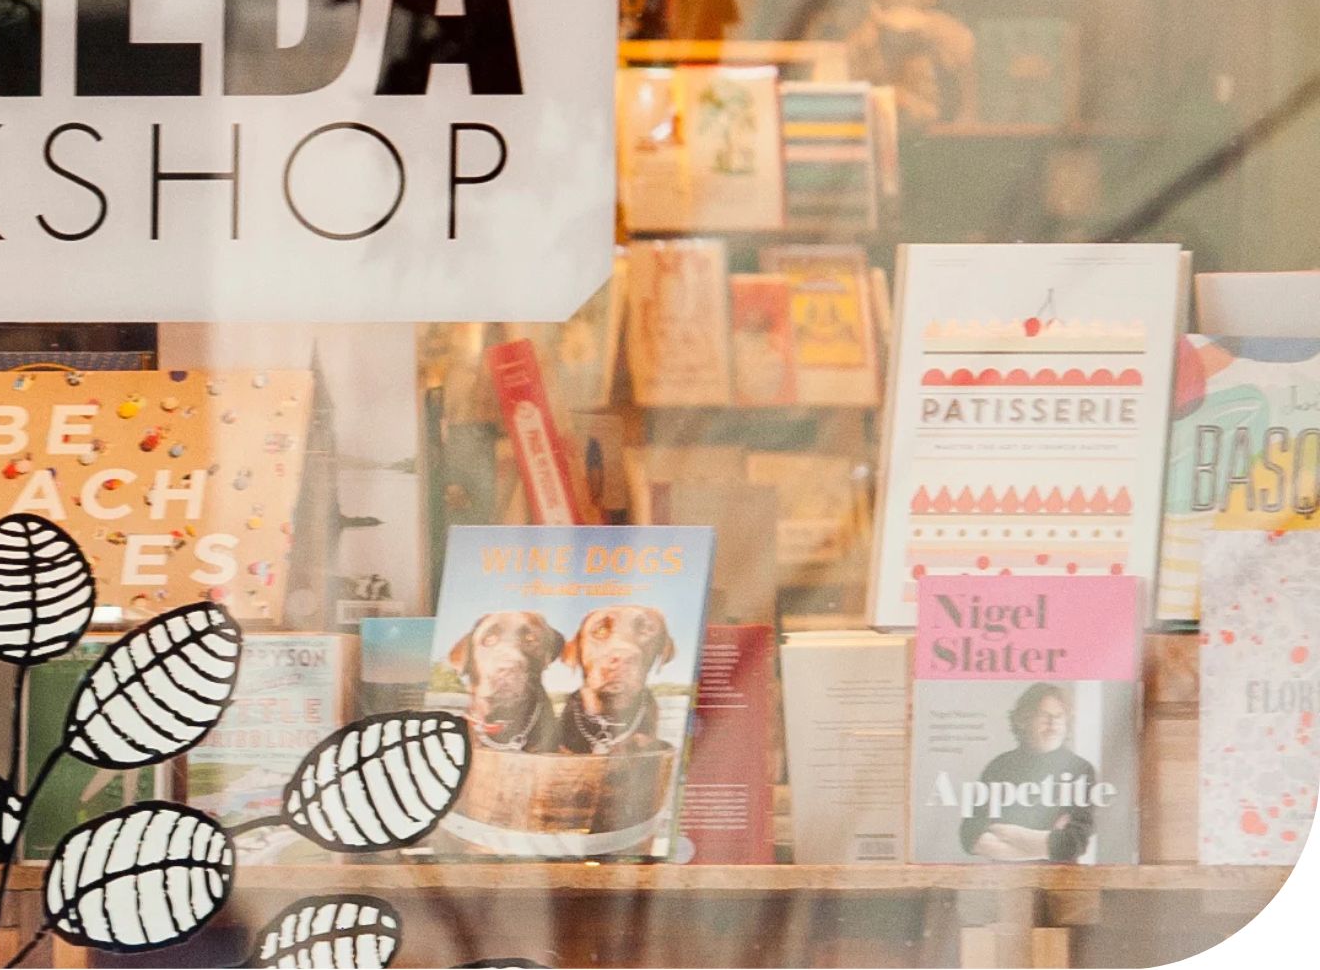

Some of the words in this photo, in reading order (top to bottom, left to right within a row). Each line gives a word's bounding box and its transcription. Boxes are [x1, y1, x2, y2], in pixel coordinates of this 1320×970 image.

[921, 397, 1137, 423] PATISSERIE
[8, 468, 207, 520] ACH
[121, 534, 239, 585] ES
[482, 545, 573, 574] WINE
[585, 545, 684, 575] DOGS
[932, 593, 1046, 641] Nigel
[932, 636, 1067, 673] Slater
[925, 771, 1118, 818] Appetite
